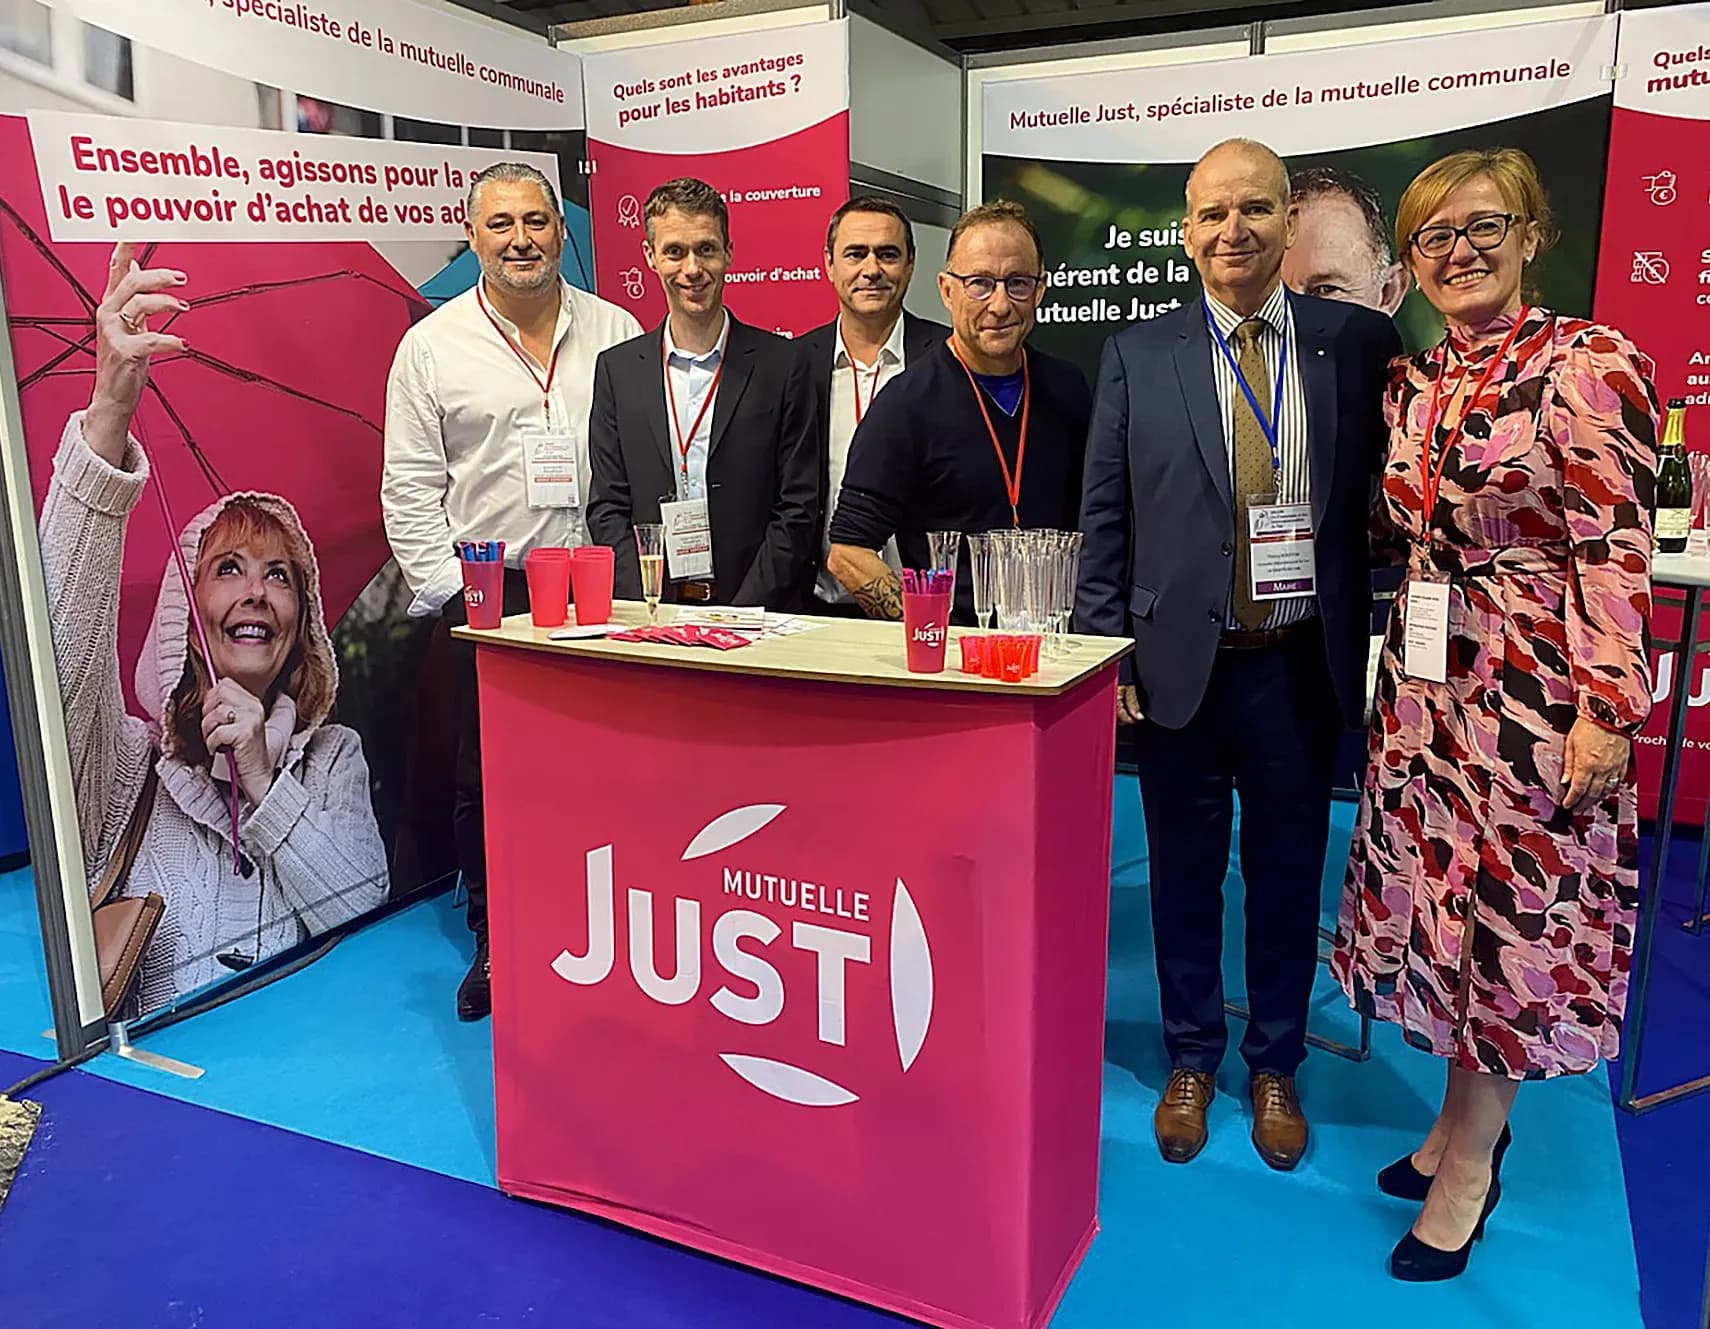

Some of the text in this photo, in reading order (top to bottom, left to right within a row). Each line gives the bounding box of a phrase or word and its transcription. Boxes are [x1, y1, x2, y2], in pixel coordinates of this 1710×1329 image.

[347, 21, 372, 47] de
[377, 28, 394, 54] la
[400, 41, 475, 77] mutuelle
[479, 65, 564, 103] communale
[614, 53, 804, 101] Quels sont les avantages
[1647, 69, 1710, 94] mutu
[618, 74, 801, 128] pour les habitants ?
[1010, 58, 1571, 129] Mutuelle Just, spécialiste de la mutuelle communale
[70, 135, 250, 185] Ensemble,
[258, 150, 378, 188] agissons
[384, 165, 438, 192] pour
[444, 161, 464, 188] la
[58, 184, 467, 229] le pouvoir d’achat de vos ad
[730, 189, 742, 203] la
[745, 185, 821, 201] couverture
[1104, 224, 1132, 249] Je
[724, 267, 821, 283] ouvoir d'achat
[1046, 259, 1190, 288] érent de la
[1036, 298, 1121, 324] utuelle
[1633, 734, 1667, 746] roch
[722, 867, 871, 922] MUTUELLE
[550, 843, 873, 1048] JUST
